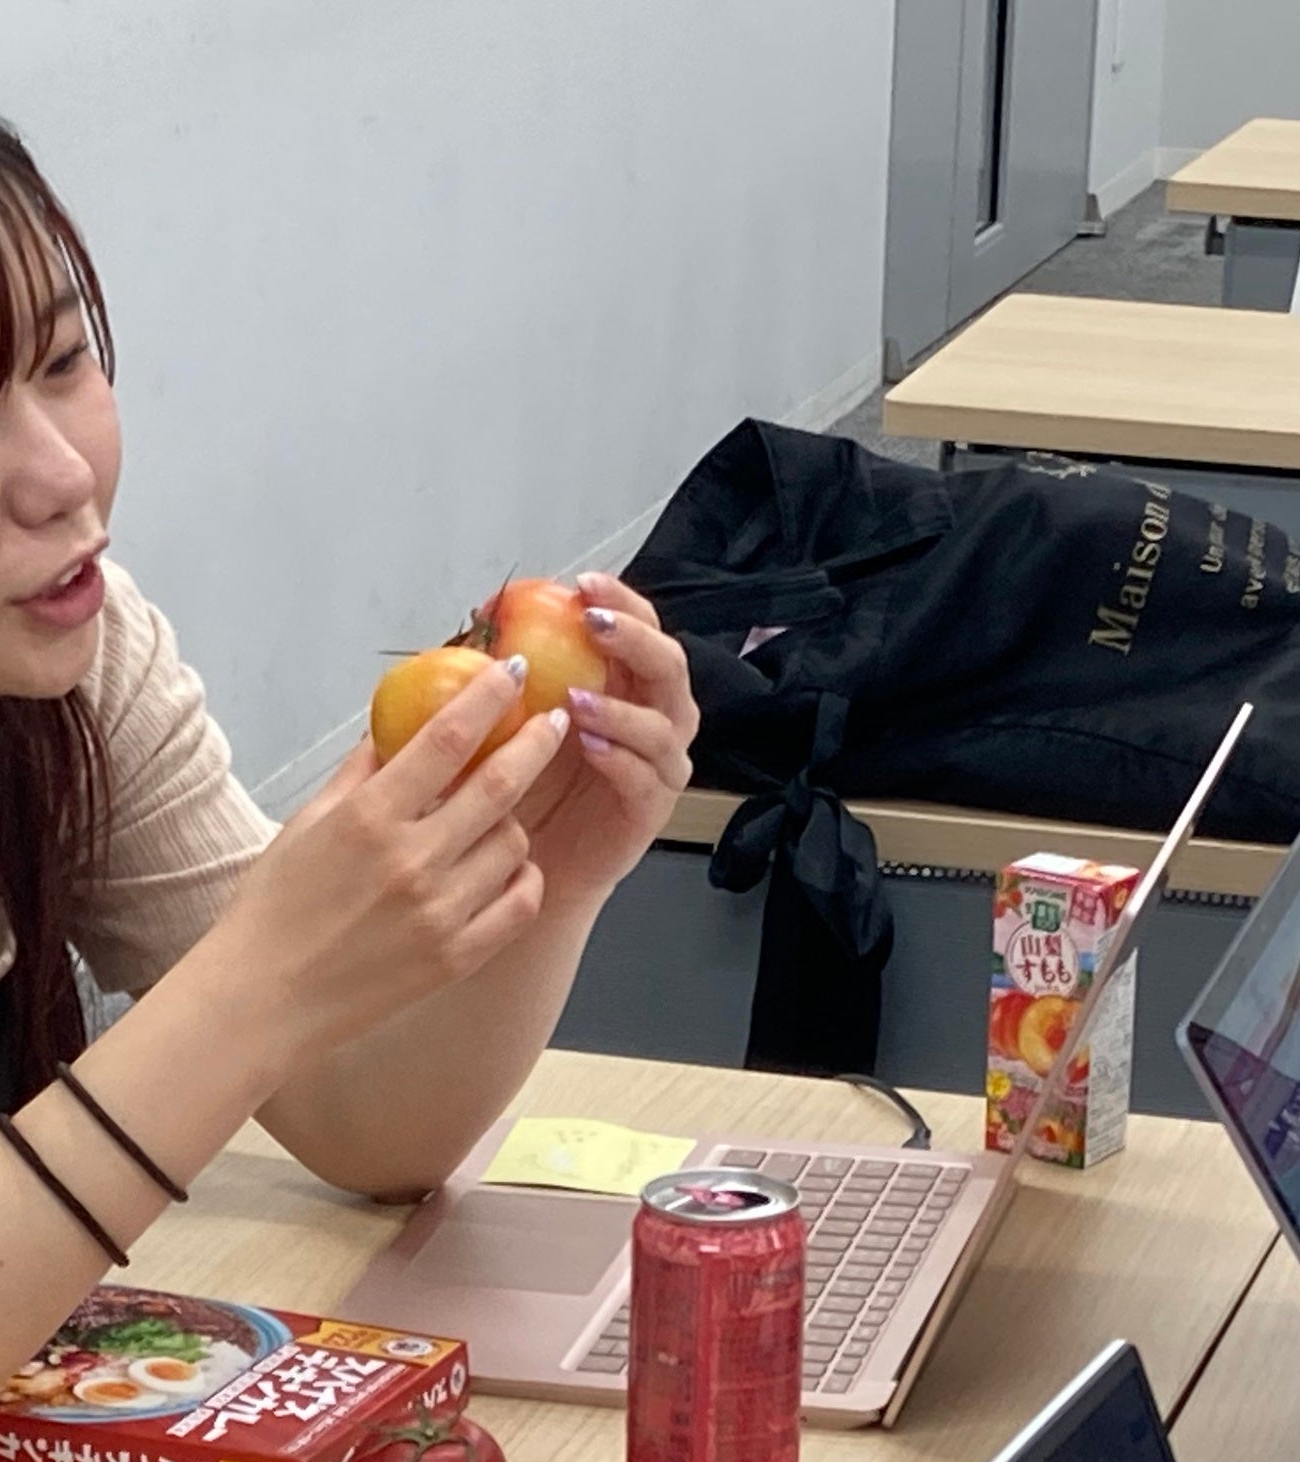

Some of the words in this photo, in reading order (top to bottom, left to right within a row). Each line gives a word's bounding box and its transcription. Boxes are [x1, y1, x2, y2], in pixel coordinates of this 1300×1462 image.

[1088, 501, 1171, 656] Maison
[1014, 958, 1072, 984] すもも
